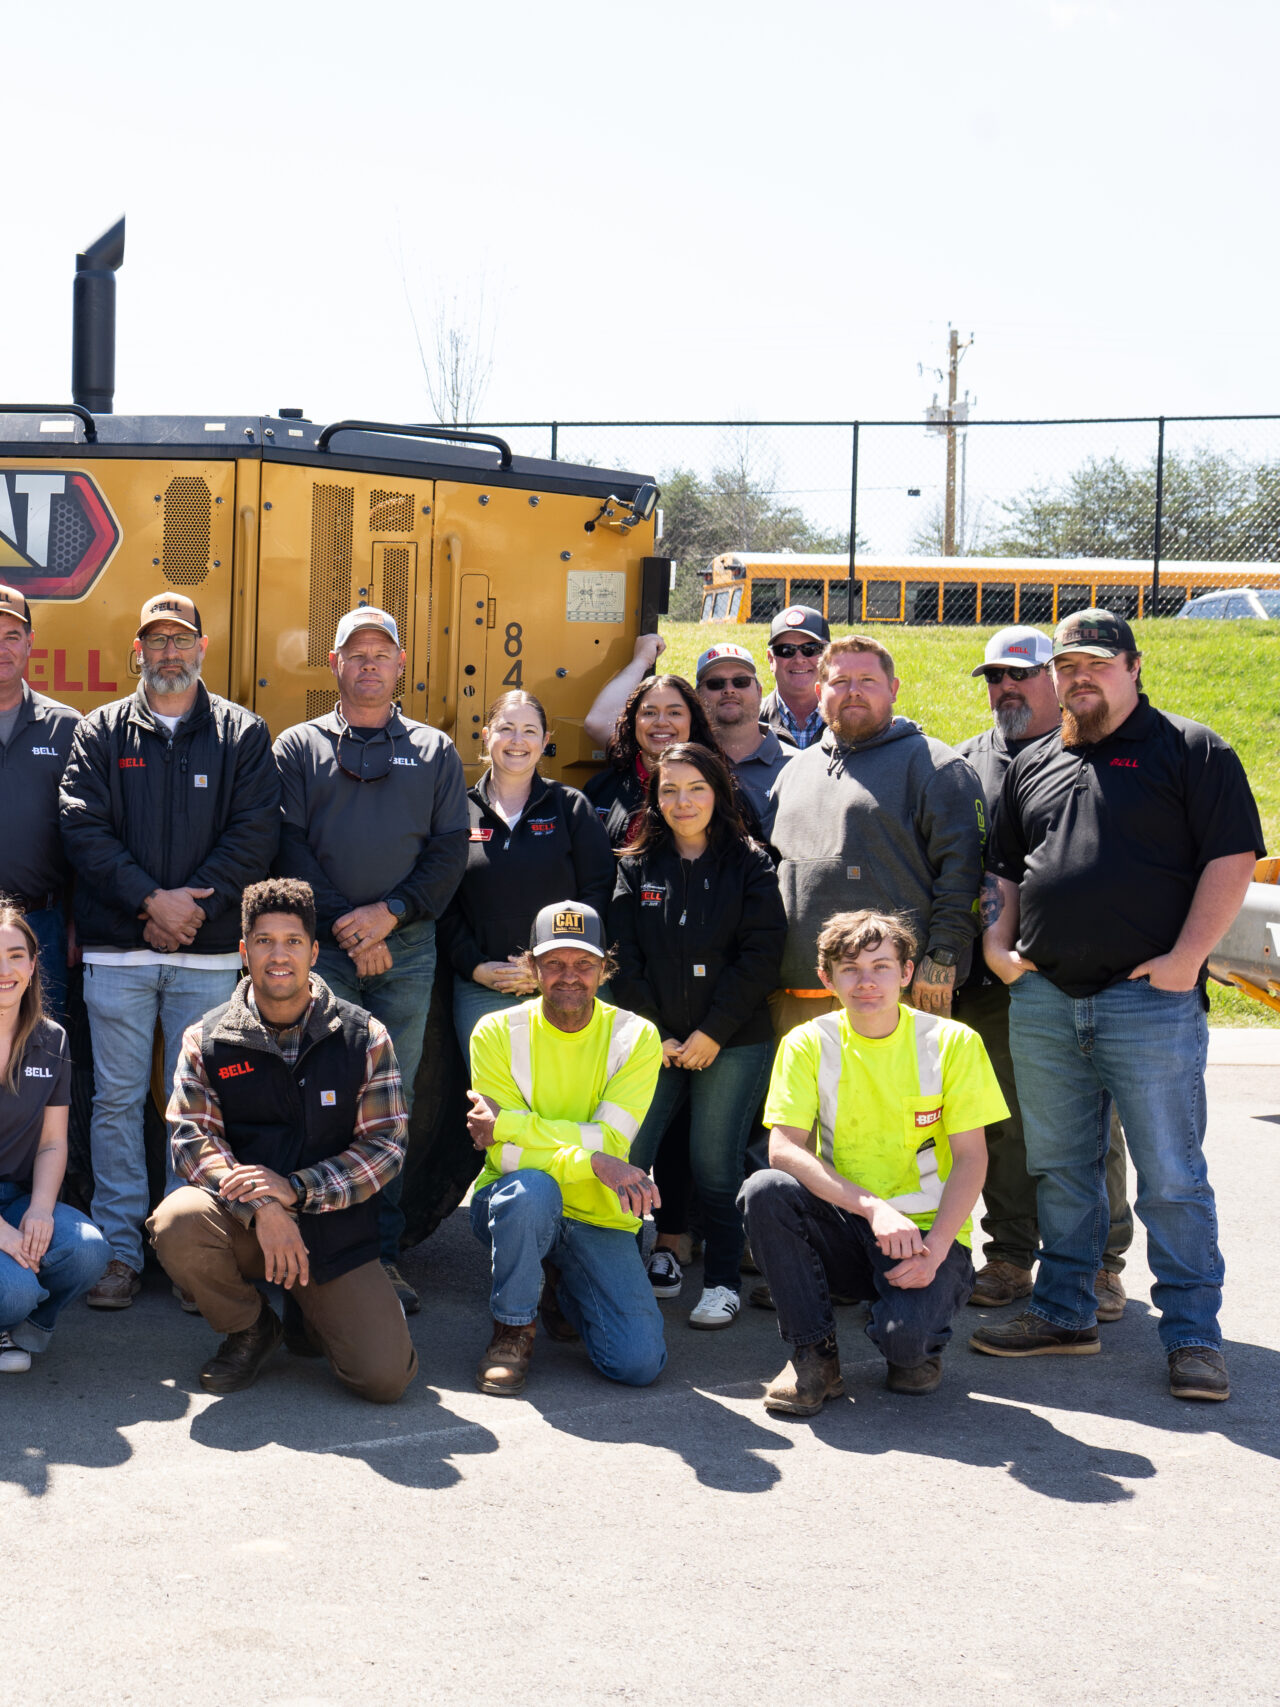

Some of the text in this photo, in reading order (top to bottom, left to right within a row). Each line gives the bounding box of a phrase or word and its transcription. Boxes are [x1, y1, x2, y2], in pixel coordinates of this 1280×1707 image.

[150, 601, 182, 613] BELL
[1064, 629, 1096, 641] BELL
[1008, 646, 1030, 655] BELL
[32, 746, 59, 756] BELL
[118, 758, 146, 768] BELL
[389, 757, 418, 766] BELL
[1109, 757, 1139, 768] BELL
[531, 823, 556, 832] BELL
[556, 913, 582, 927] CAT
[24, 1066, 53, 1078] BELL
[218, 1061, 254, 1080] BELL
[916, 1109, 941, 1125] BELL
